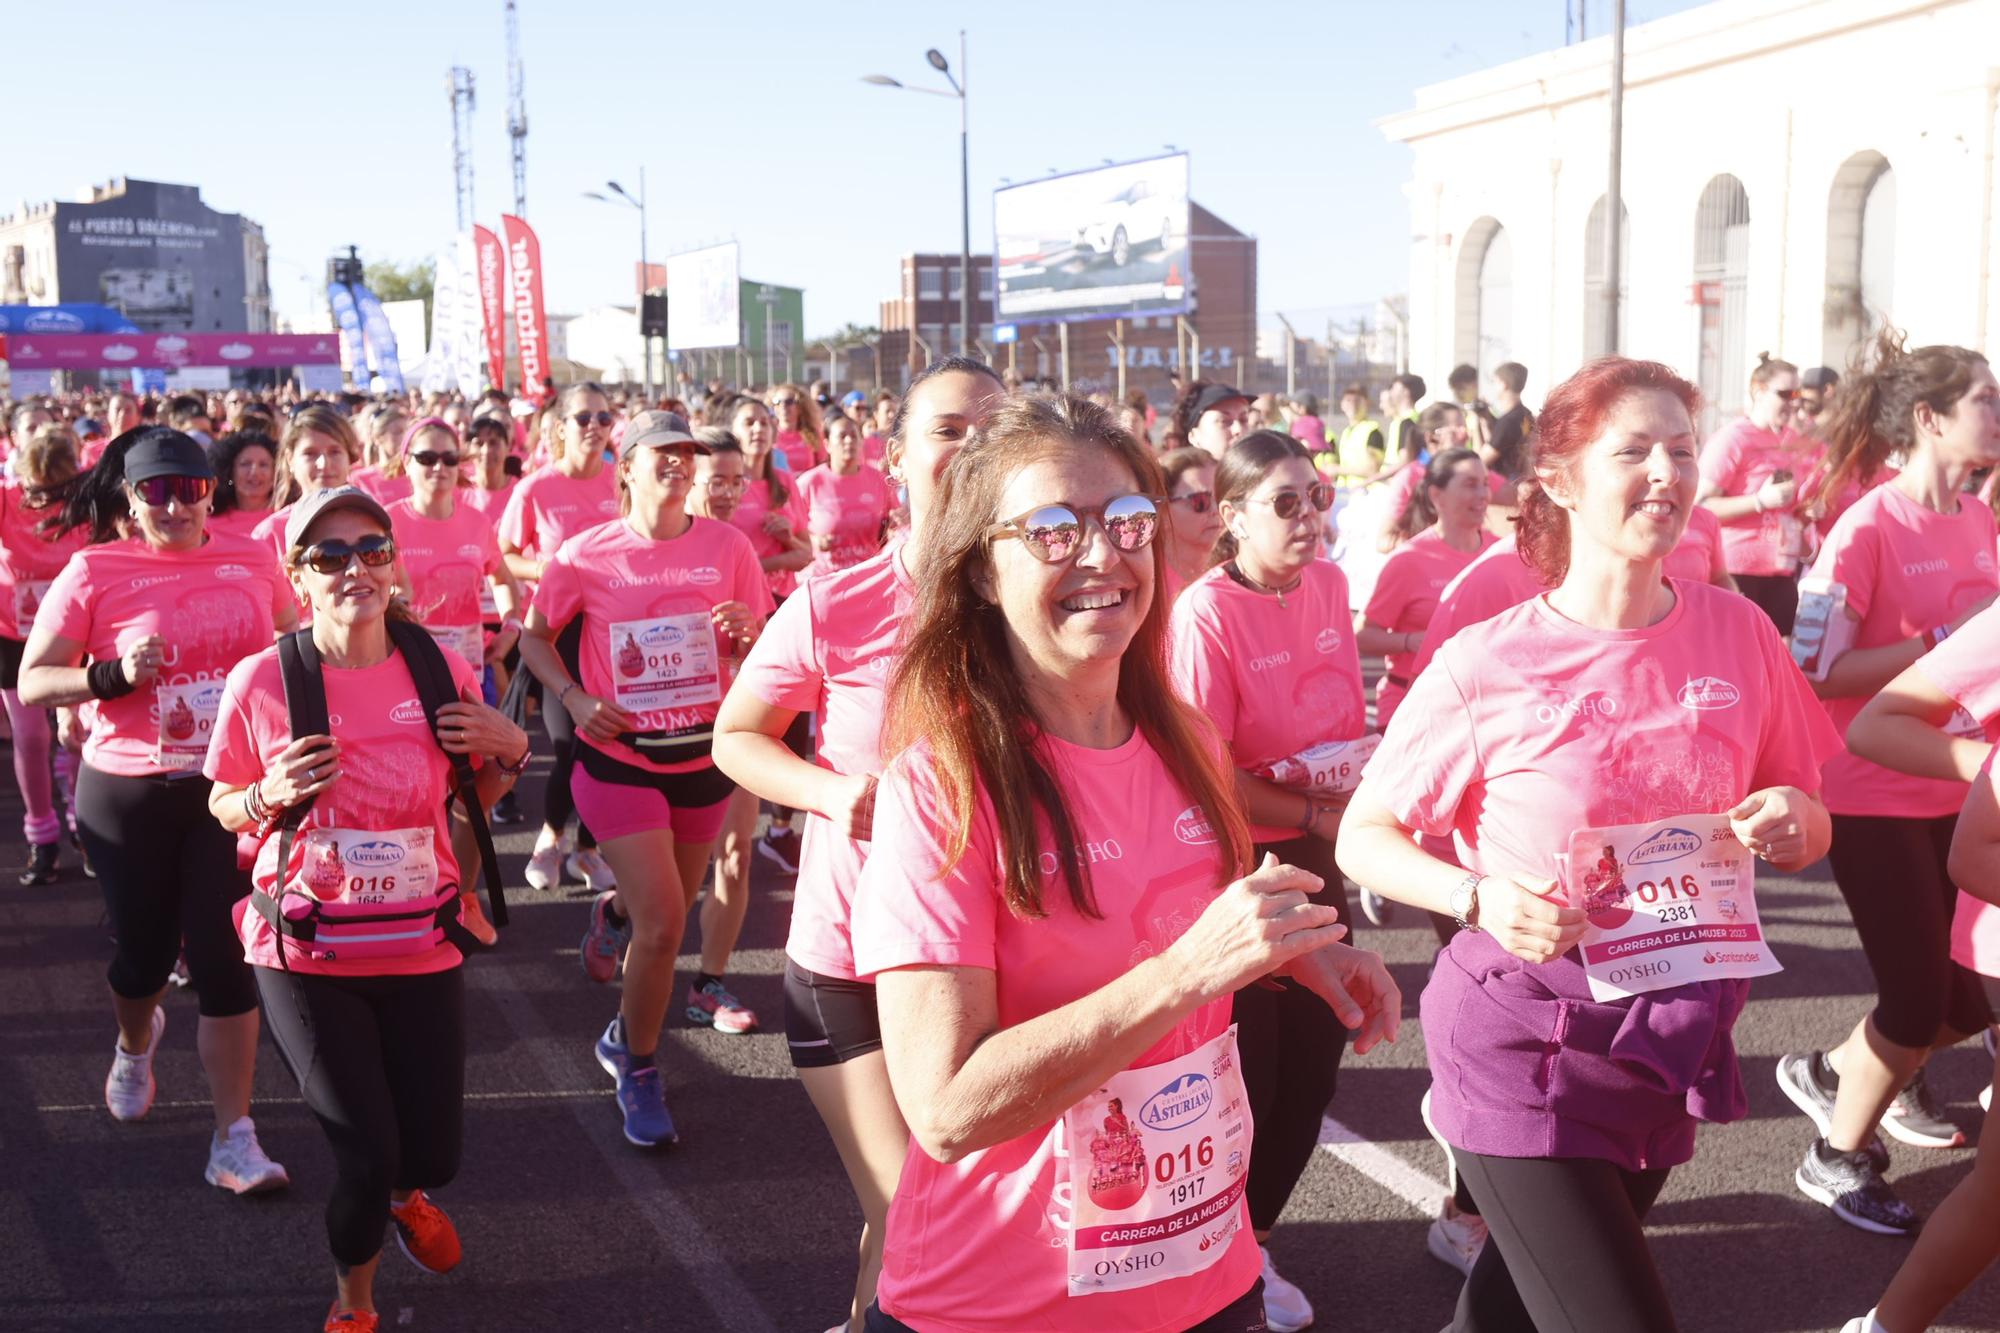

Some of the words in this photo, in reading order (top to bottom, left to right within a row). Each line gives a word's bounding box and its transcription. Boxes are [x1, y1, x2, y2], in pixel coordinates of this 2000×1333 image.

[648, 652, 682, 669] 016
[1249, 650, 1290, 671] OYSHO
[656, 669, 678, 679] 1423
[1685, 688, 1737, 704] ASTURIANA
[1536, 696, 1616, 724] OYSHO
[1315, 761, 1350, 786] 016
[1710, 833, 1736, 842] SUM
[351, 849, 400, 861] ASTURIANA
[1038, 838, 1122, 875] OSHO
[1632, 841, 1695, 862] ASTURIANA
[350, 876, 395, 892] 016
[1637, 874, 1700, 903] 016
[357, 895, 385, 904] 1642
[1658, 904, 1697, 923] 2381
[1608, 937, 1663, 955] CARRERA
[1665, 934, 1681, 944] DE
[1682, 931, 1697, 941] LA
[1699, 928, 1727, 938] MUJER
[1729, 928, 1747, 938] 2023
[1716, 951, 1760, 963] Santander
[1609, 959, 1671, 984] OYSHO
[1147, 1088, 1210, 1123] ASTURIANA
[1155, 1136, 1214, 1183] 016
[1169, 1176, 1205, 1206] 1917
[1100, 1225, 1165, 1243] CARRERA
[1168, 1218, 1184, 1233] DE
[1185, 1212, 1199, 1226] LA
[1200, 1195, 1229, 1219] MUJER
[1095, 1251, 1165, 1276] OYSHO
